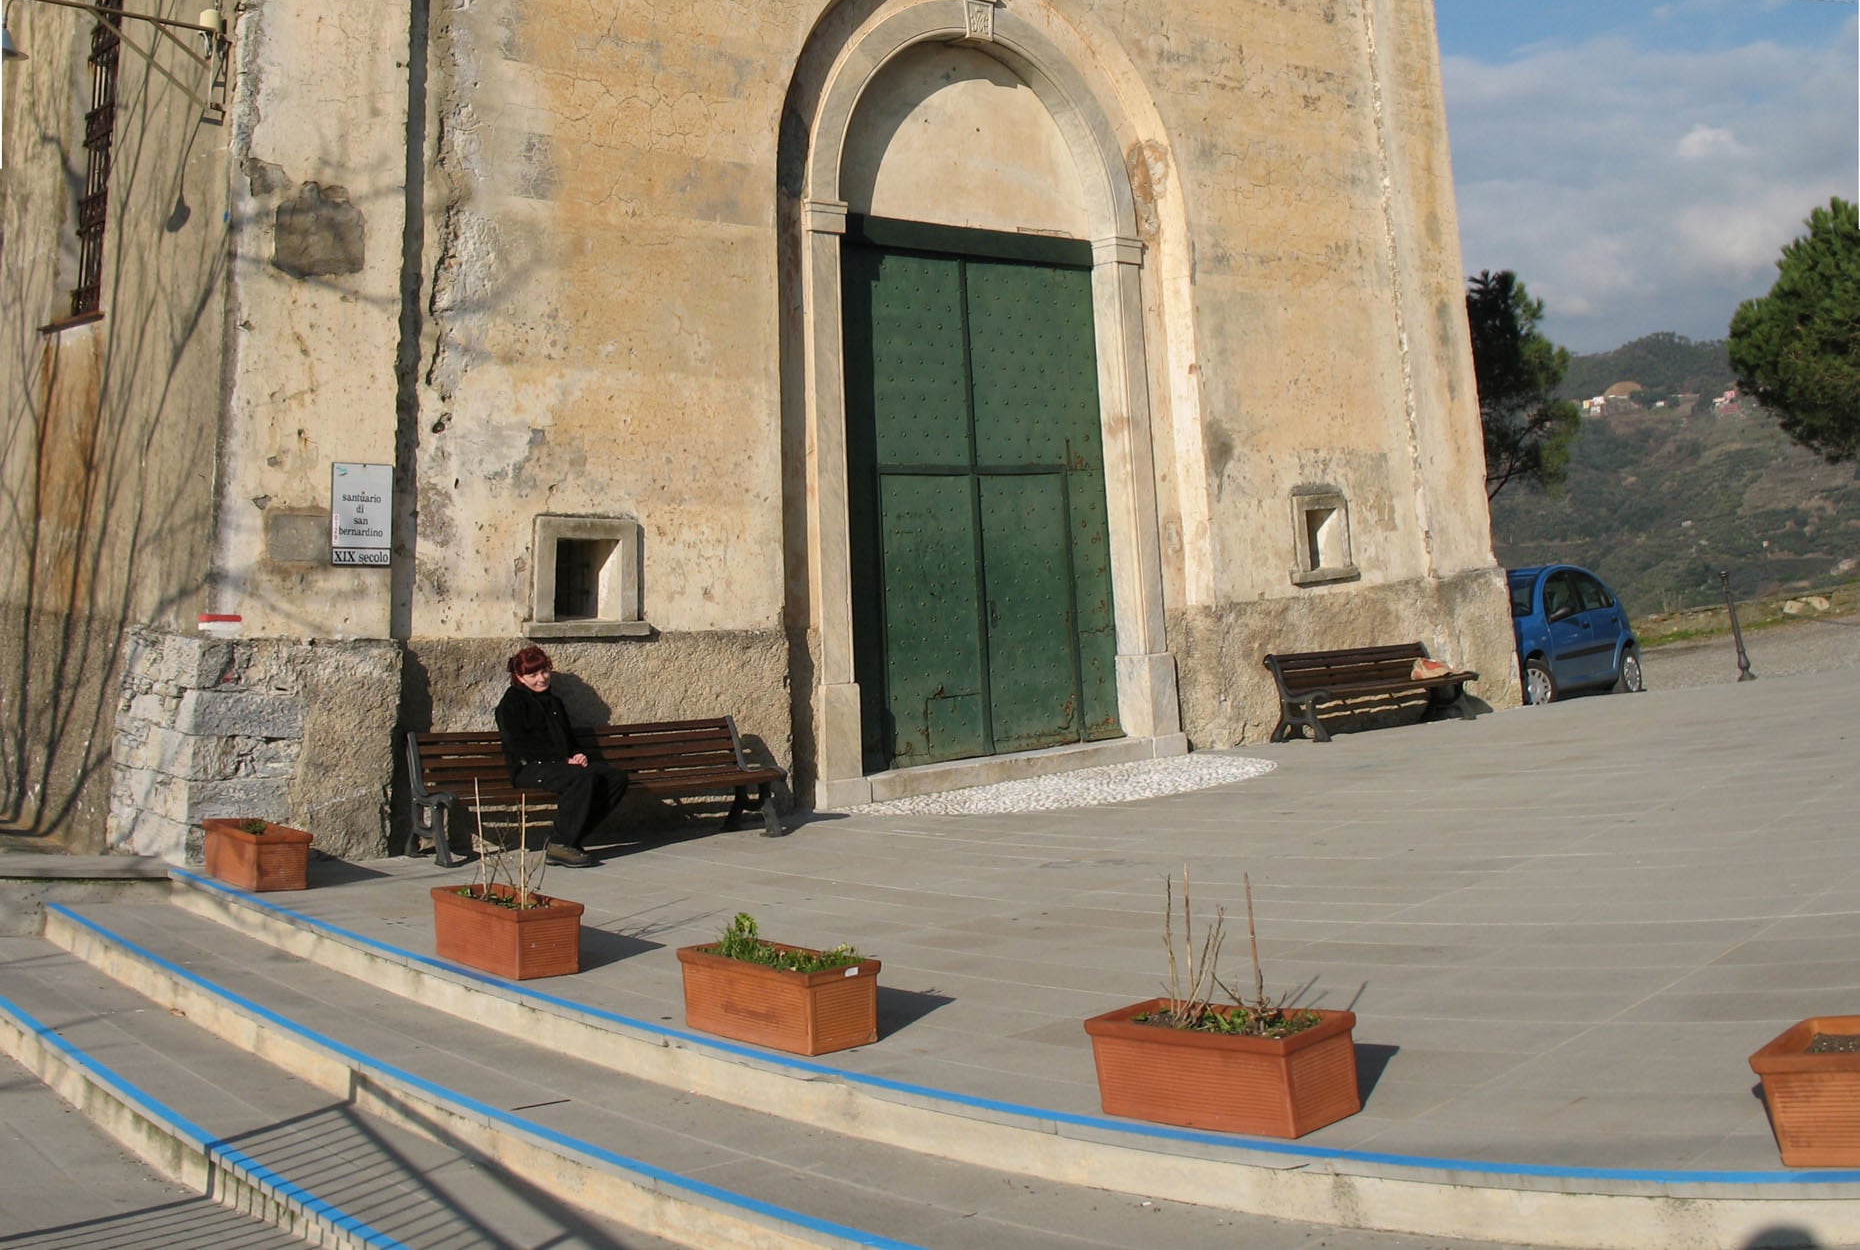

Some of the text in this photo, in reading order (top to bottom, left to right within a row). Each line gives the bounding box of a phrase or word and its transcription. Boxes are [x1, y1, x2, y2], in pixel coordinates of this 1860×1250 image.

[342, 493, 382, 503] santuario
[356, 504, 364, 513] di
[353, 517, 368, 525] san
[338, 526, 383, 537] bernardino
[334, 551, 389, 563] XIX secolo
